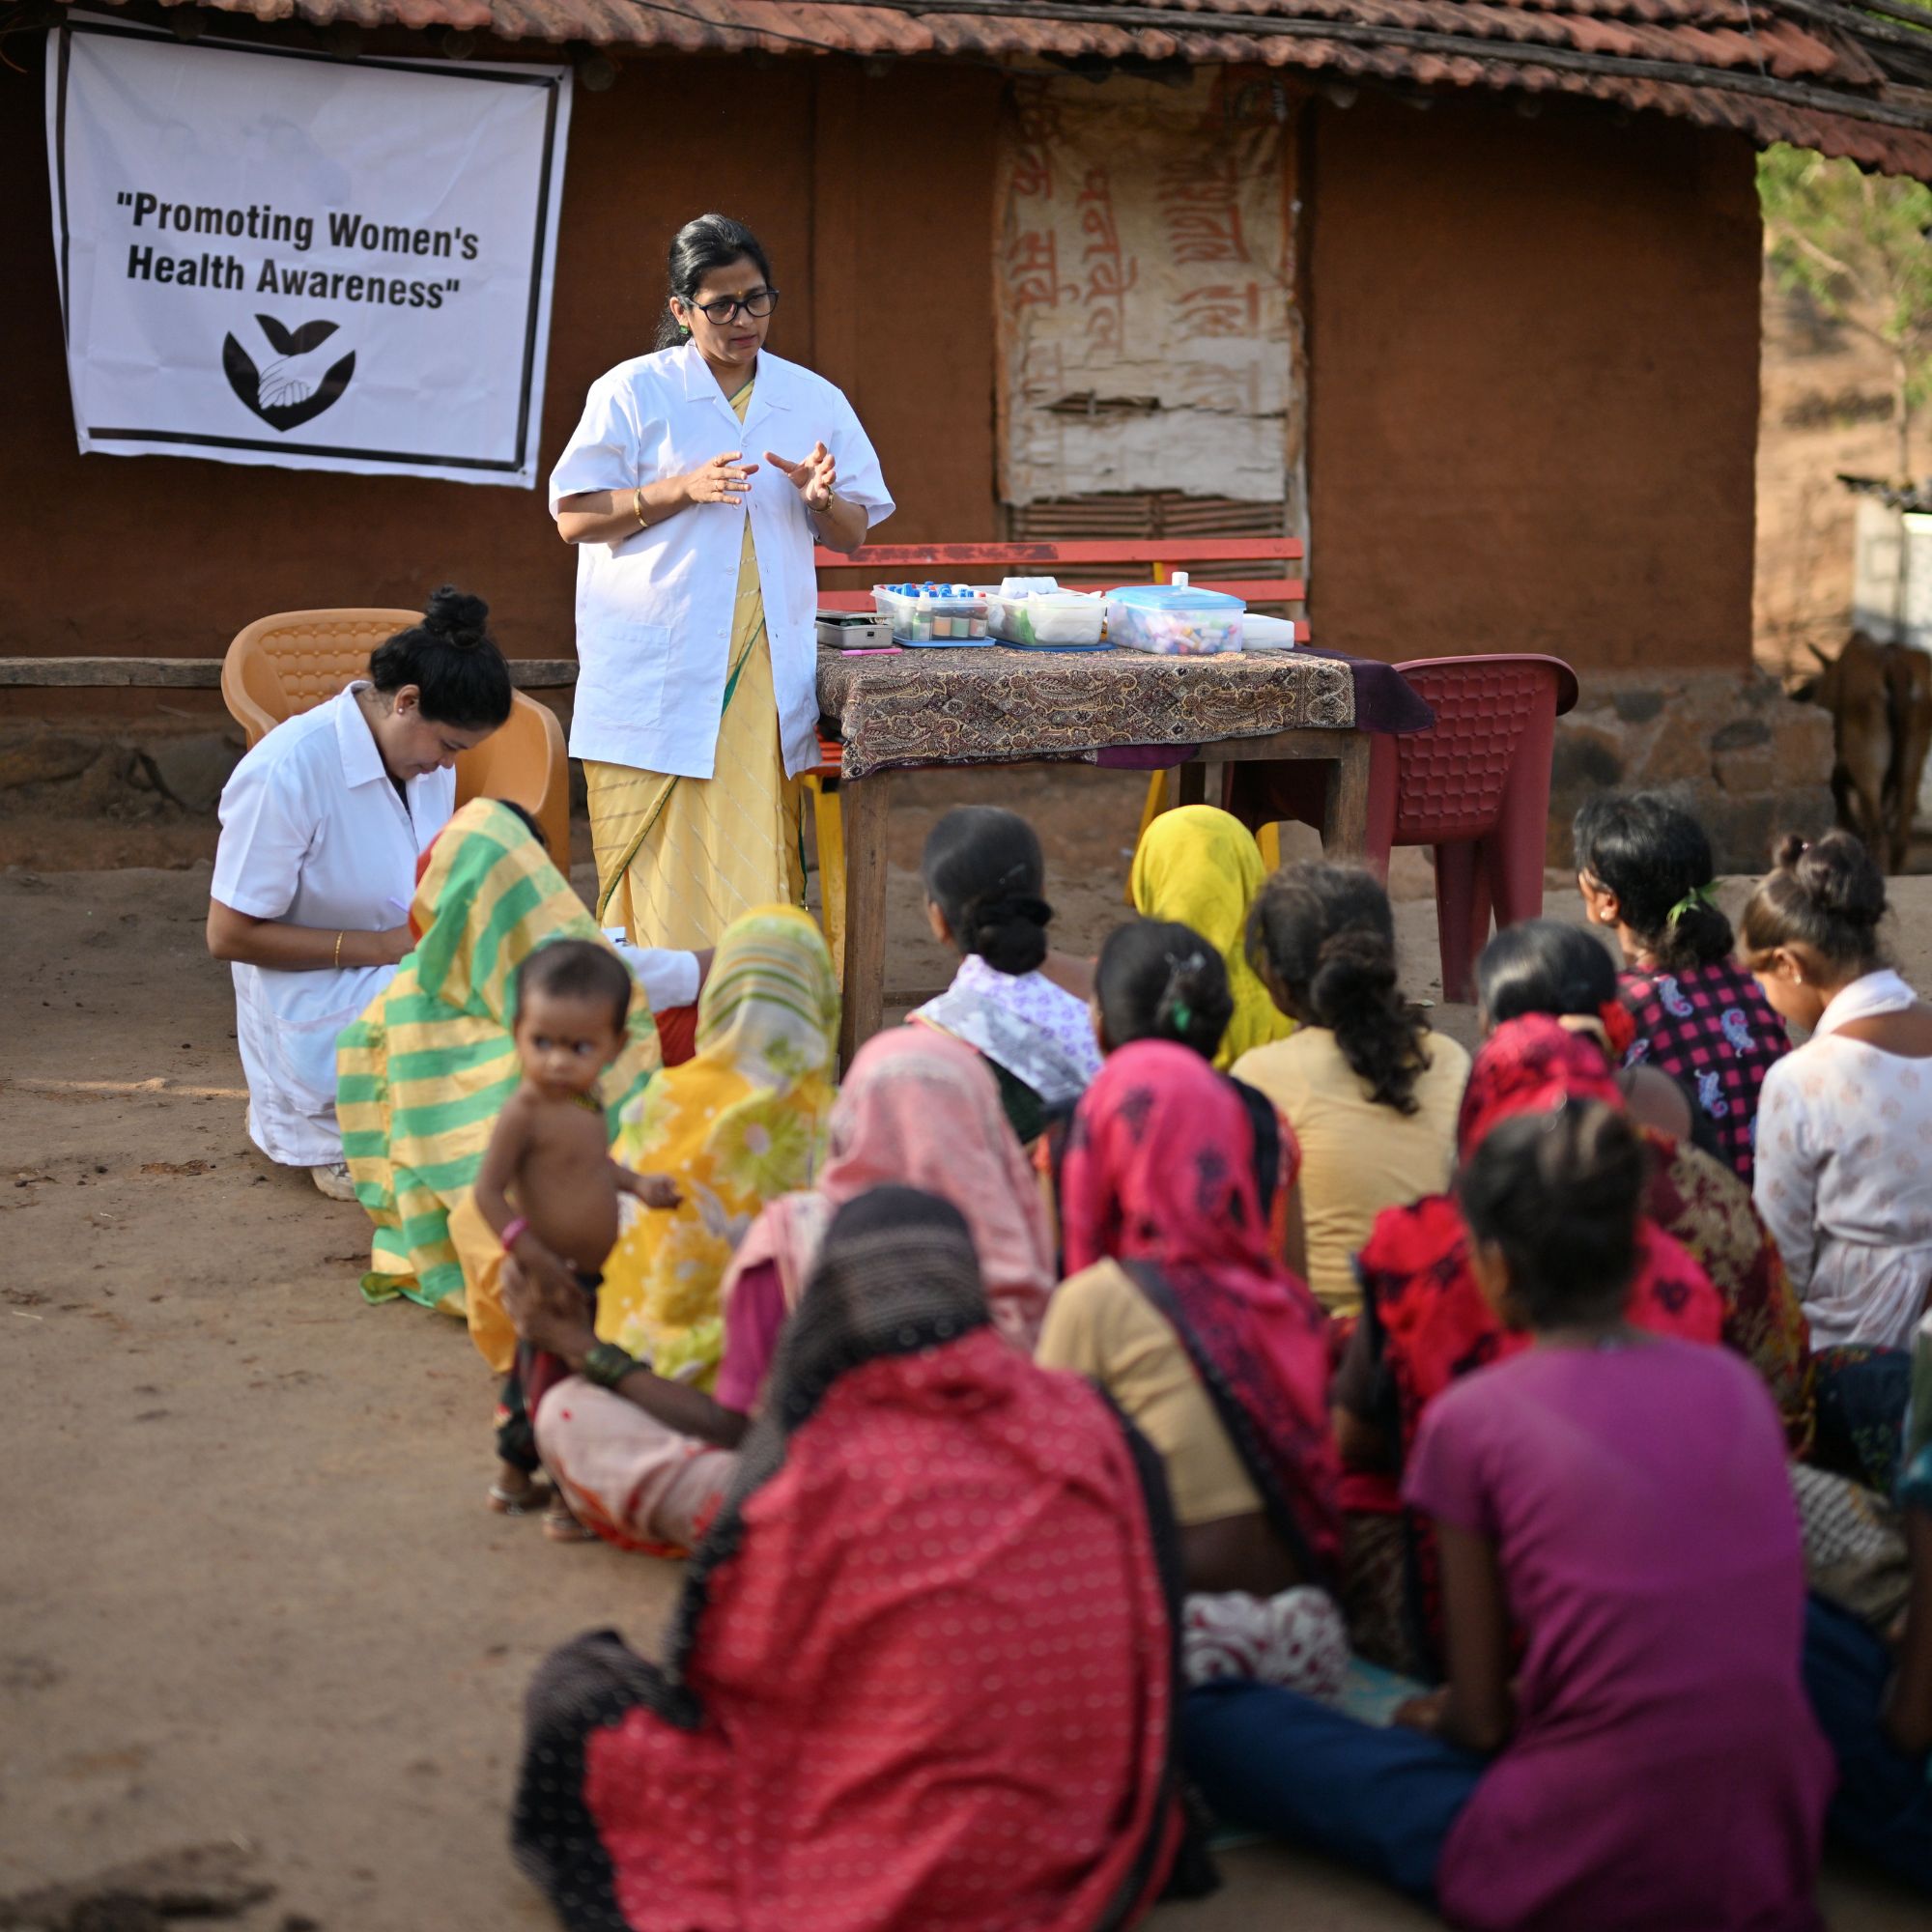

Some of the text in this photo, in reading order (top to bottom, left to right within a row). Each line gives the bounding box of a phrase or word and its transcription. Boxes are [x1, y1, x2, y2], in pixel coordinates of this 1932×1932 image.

[117, 191, 480, 261] "Promoting Women's
[127, 244, 461, 309] Health Awareness"
